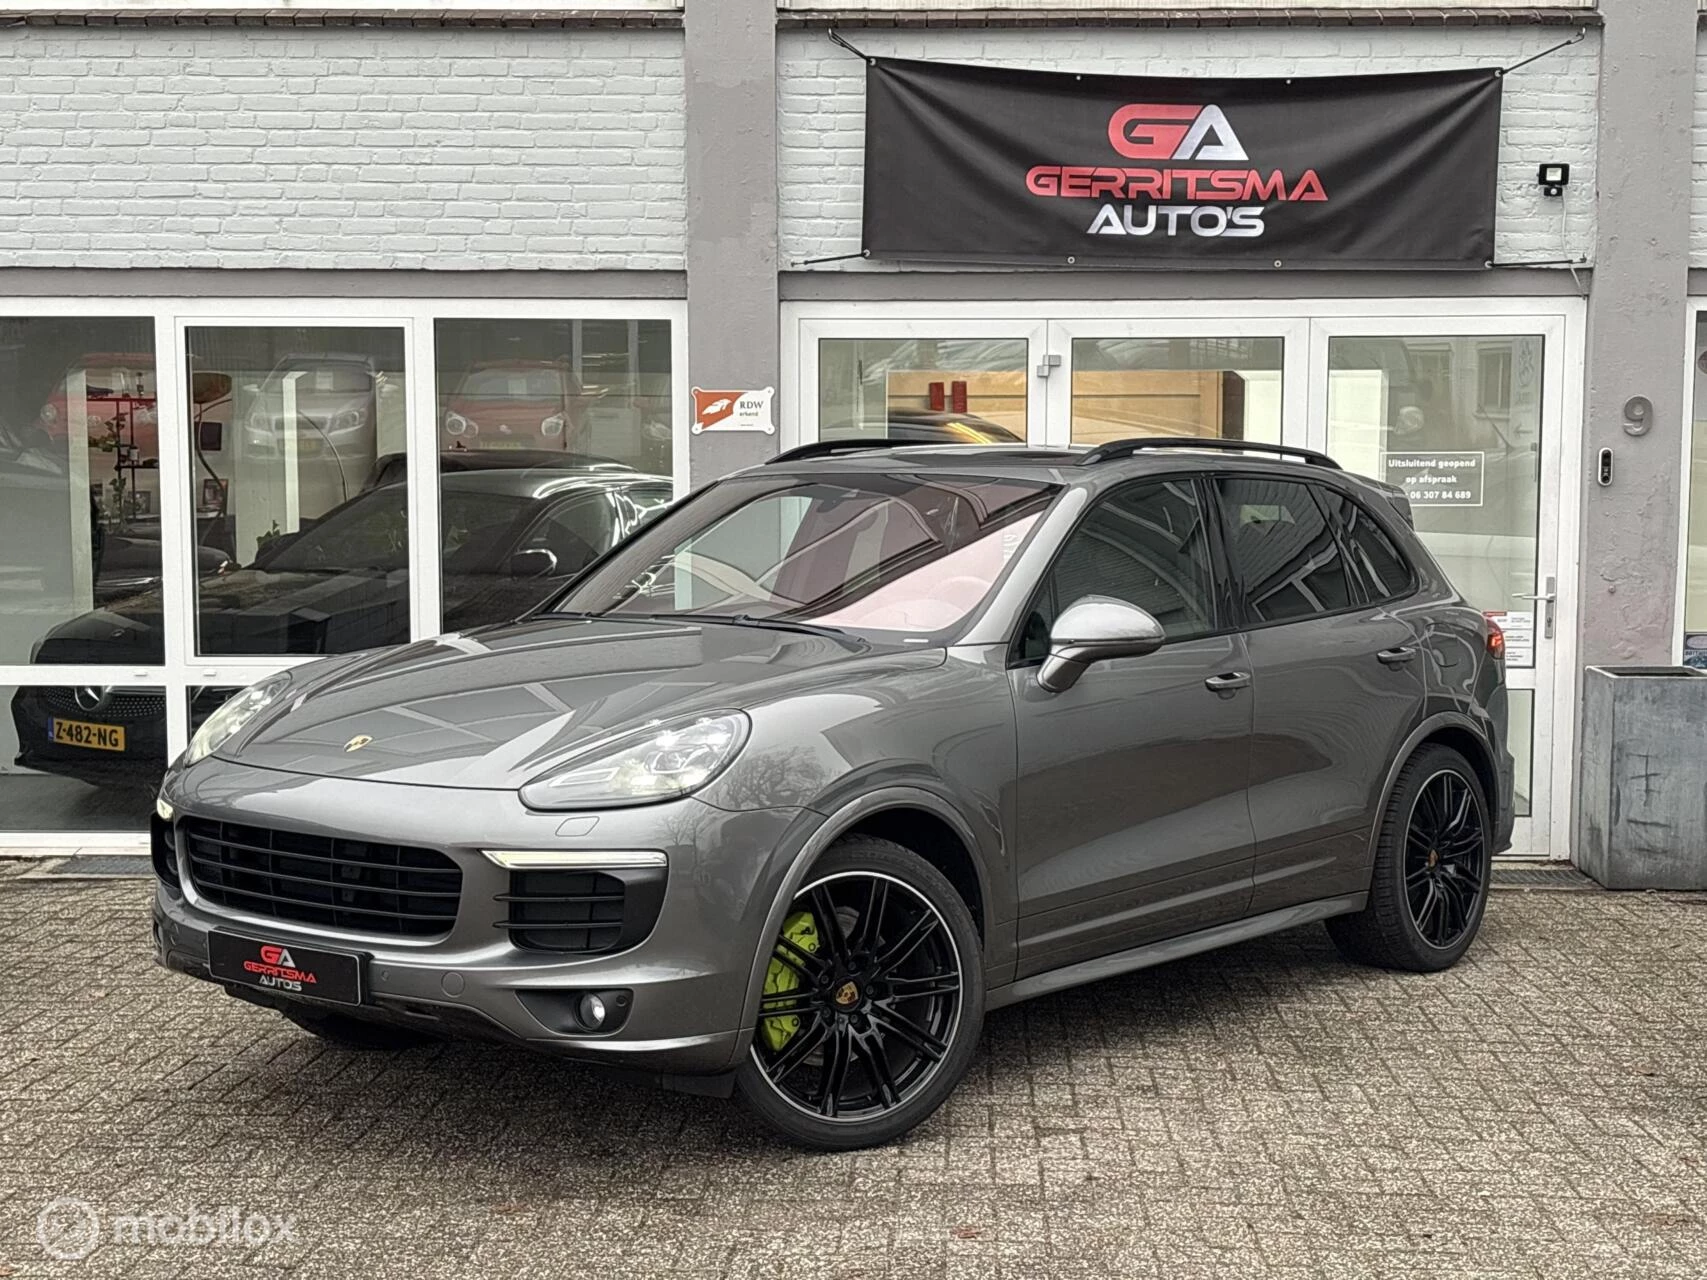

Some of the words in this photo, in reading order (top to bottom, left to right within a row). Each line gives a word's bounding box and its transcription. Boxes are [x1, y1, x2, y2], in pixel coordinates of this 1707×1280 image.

[1107, 103, 1249, 161] GA
[1025, 165, 1329, 201] GERRITSMA
[1086, 203, 1265, 237] AUTO'S
[740, 401, 764, 409] RDW
[1623, 395, 1653, 436] 9
[1388, 459, 1436, 468] Uitsluitend
[1438, 459, 1476, 469] geopend
[1405, 476, 1417, 484] op
[1419, 475, 1457, 484] afspraak
[1410, 491, 1421, 499] 06
[1423, 491, 1439, 499] 307
[1441, 491, 1453, 499] 84
[1454, 491, 1471, 499] 689
[55, 721, 119, 747] Z-482-NG
[260, 945, 296, 968] GA
[243, 960, 317, 984] GERRITSMA
